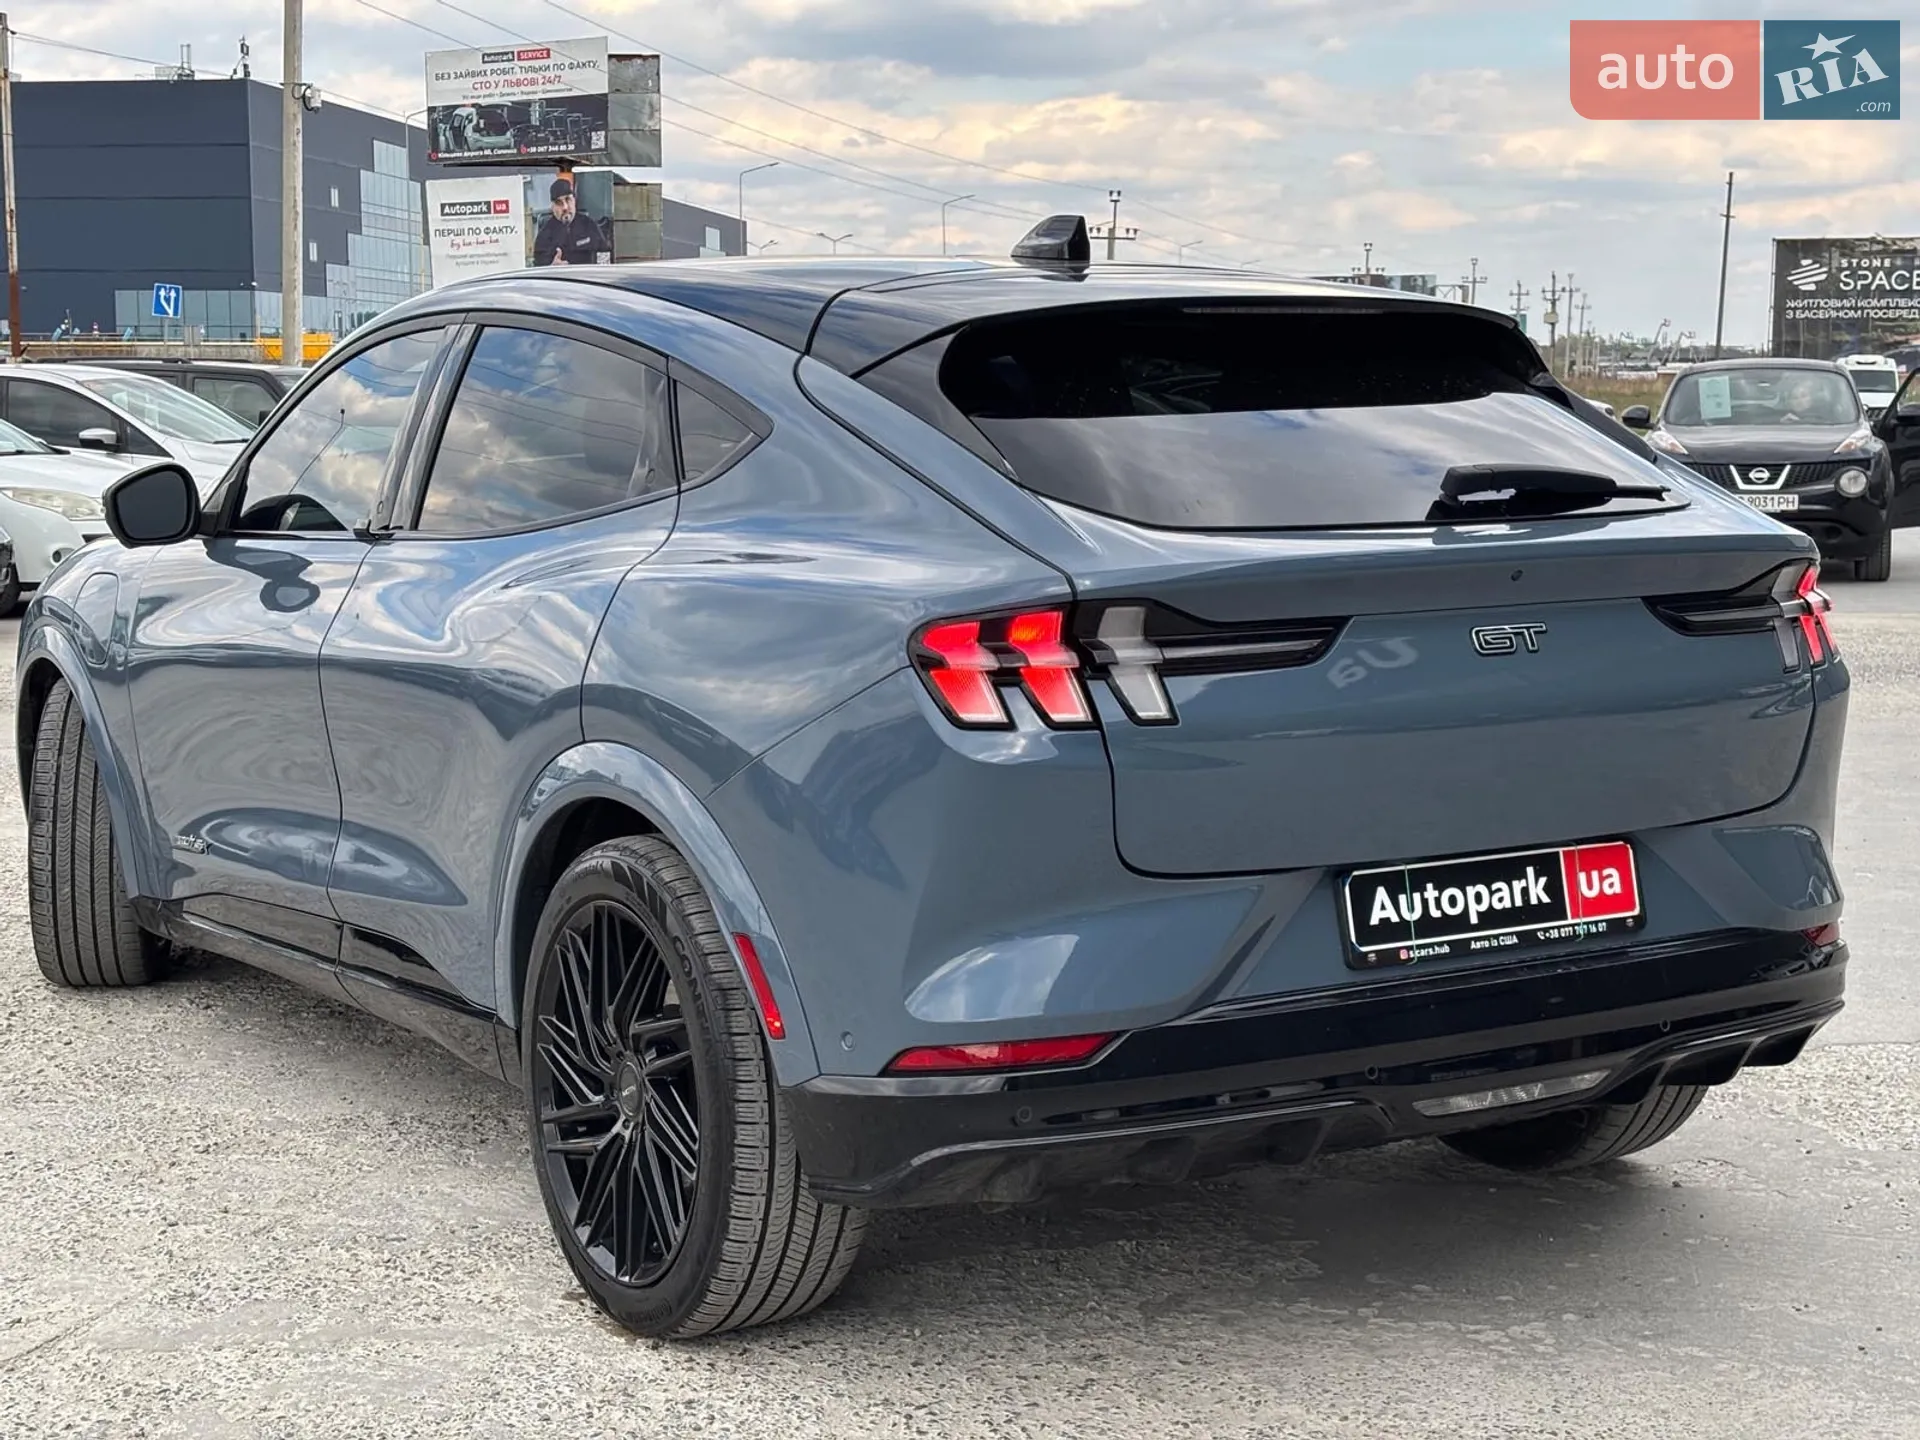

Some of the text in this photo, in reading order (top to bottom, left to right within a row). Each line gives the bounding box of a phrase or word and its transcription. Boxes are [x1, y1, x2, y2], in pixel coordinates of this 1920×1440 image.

[435, 59, 600, 81] БЕЗ ЗАЙВИХ РОБІТ. ТІЛЬКИ ПО ФАКТУ.
[472, 74, 562, 91] СТО У ЛЬВОВІ 24/7
[443, 202, 507, 215] Autopark ua
[434, 225, 518, 238] ПЕРШІ ПО ФАКТУ.
[1840, 258, 1892, 268] STONE
[1839, 270, 1920, 291] SPACE
[1786, 297, 1856, 308] ЖИТЛОВИЙ
[1795, 308, 1862, 319] БАСЕЙНОМ
[1747, 496, 1775, 508] 9031
[1470, 623, 1548, 657] GT
[1369, 866, 1623, 926] Autopark ua
[1545, 928, 1560, 939] +38
[1560, 926, 1574, 937] 077
[1597, 921, 1607, 932] 07
[1470, 939, 1490, 950] Авто
[1498, 934, 1519, 946] США
